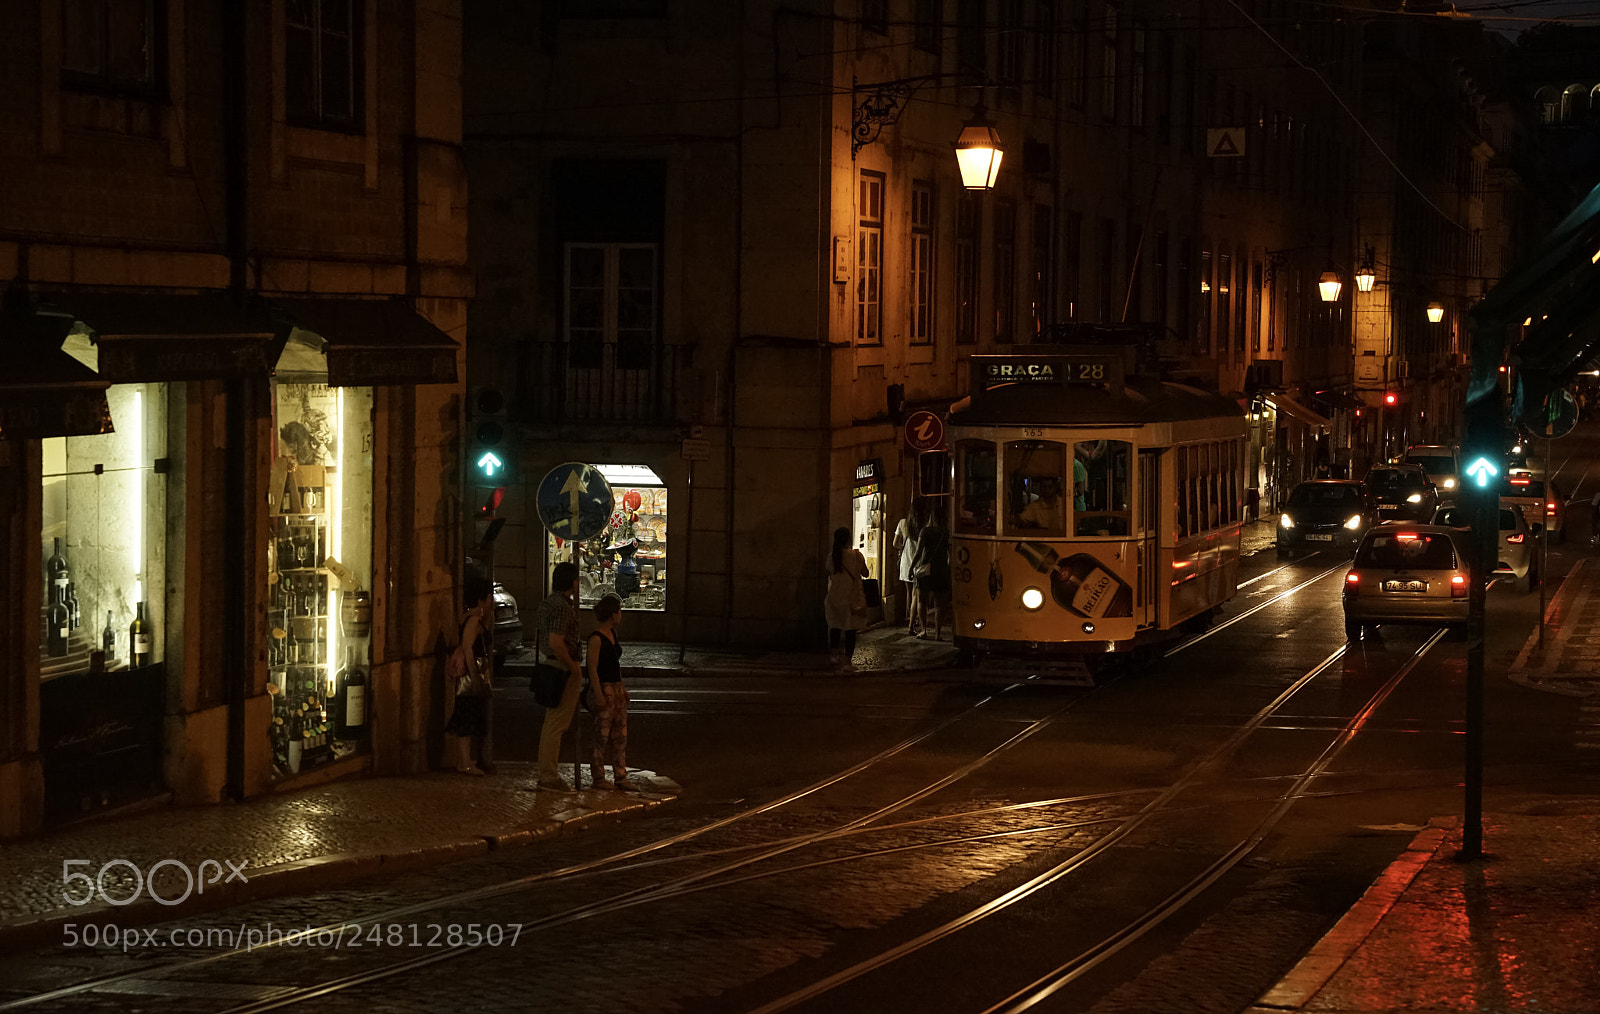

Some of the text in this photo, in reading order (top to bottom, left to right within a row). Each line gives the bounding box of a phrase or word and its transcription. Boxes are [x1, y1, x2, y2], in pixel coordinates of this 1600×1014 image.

[987, 364, 1105, 380] GRAÇA 28
[1024, 428, 1043, 437] 565
[1082, 576, 1110, 613] BEIRÃO
